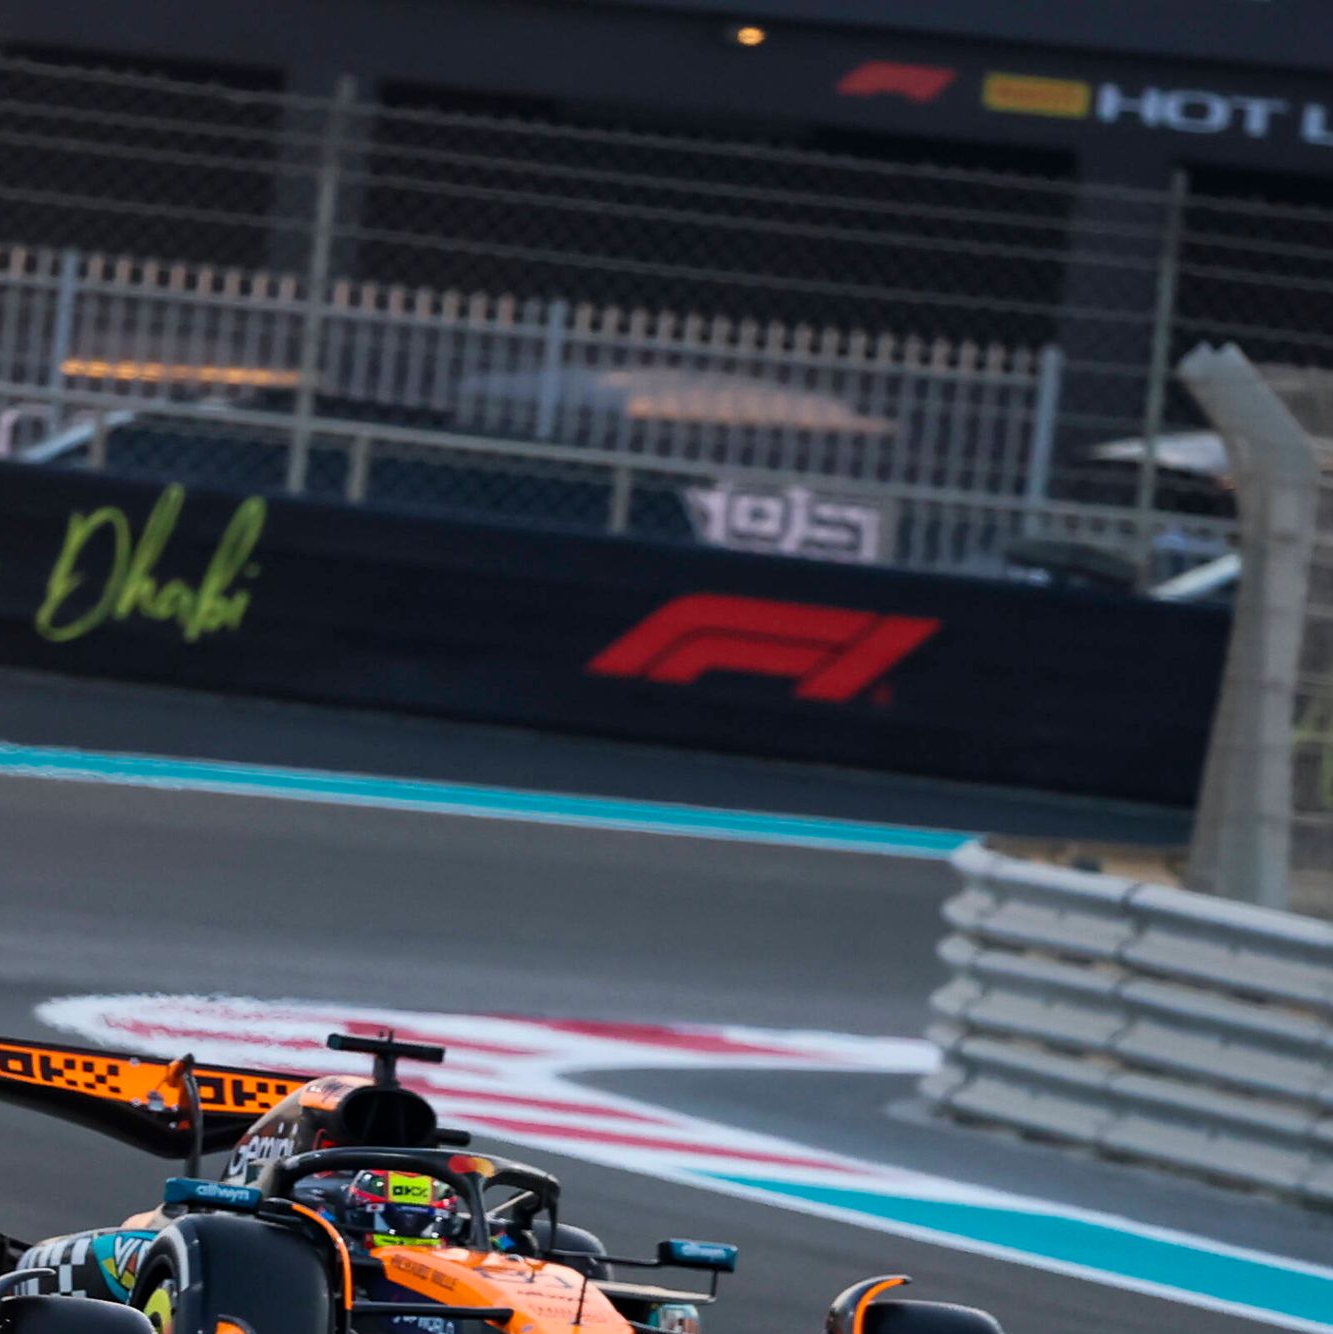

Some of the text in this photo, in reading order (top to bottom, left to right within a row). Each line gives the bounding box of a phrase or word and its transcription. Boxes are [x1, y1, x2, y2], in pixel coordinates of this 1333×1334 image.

[1095, 81, 1287, 138] HOT
[35, 482, 267, 644] Dhabi
[586, 593, 941, 702] F1
